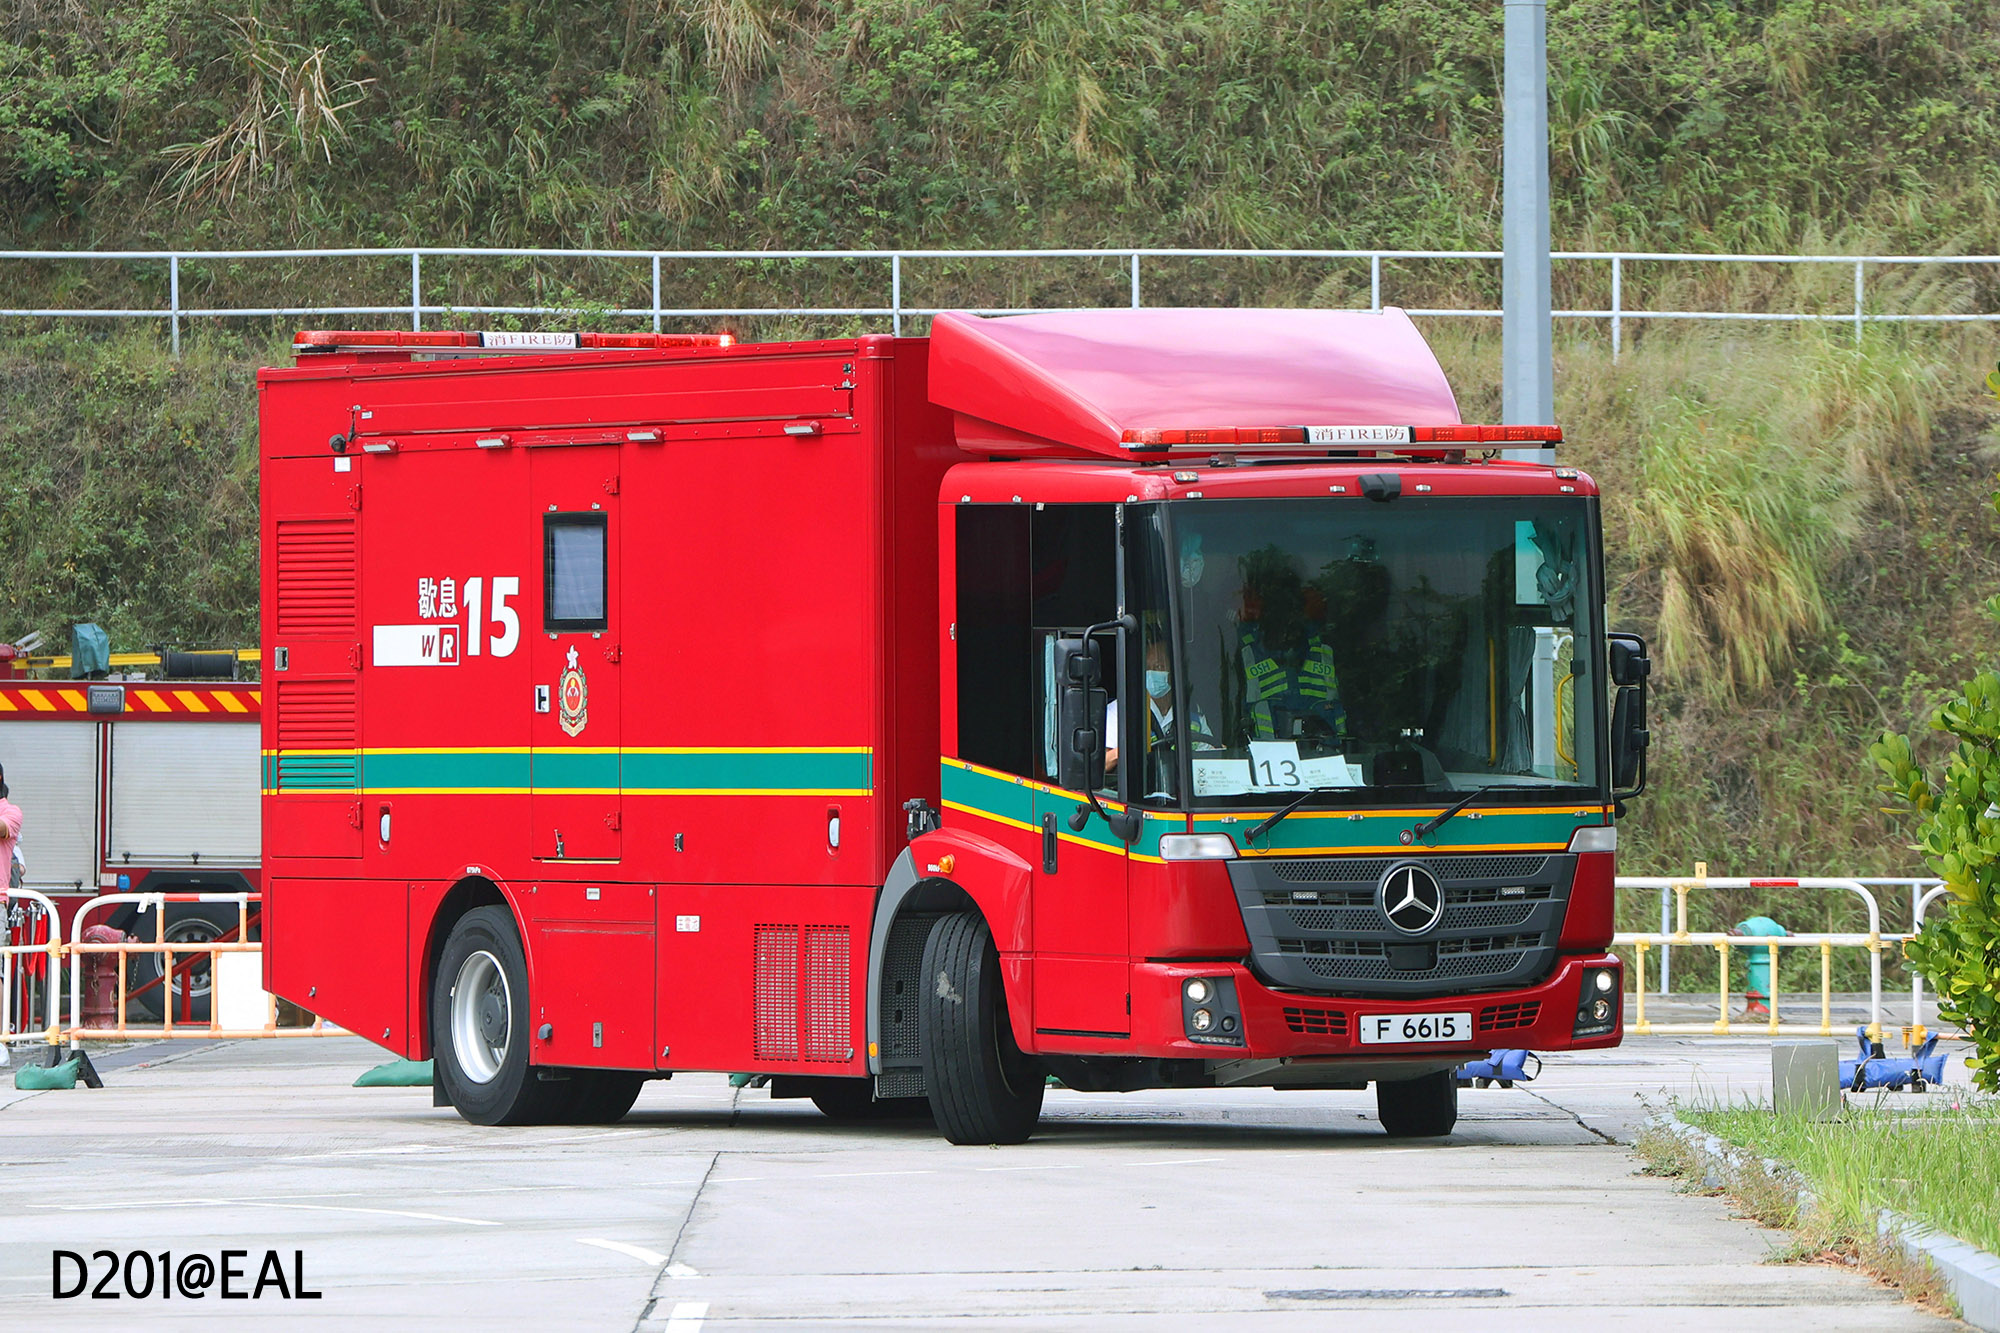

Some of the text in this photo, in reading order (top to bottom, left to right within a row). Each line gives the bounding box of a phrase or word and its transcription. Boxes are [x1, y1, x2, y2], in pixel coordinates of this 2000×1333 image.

[418, 576, 458, 619] 歇息
[462, 576, 520, 658] 15
[1249, 661, 1271, 677] OSH
[1312, 662, 1332, 676] FSD
[1259, 759, 1301, 787] 13
[1377, 1016, 1456, 1040] F 6615
